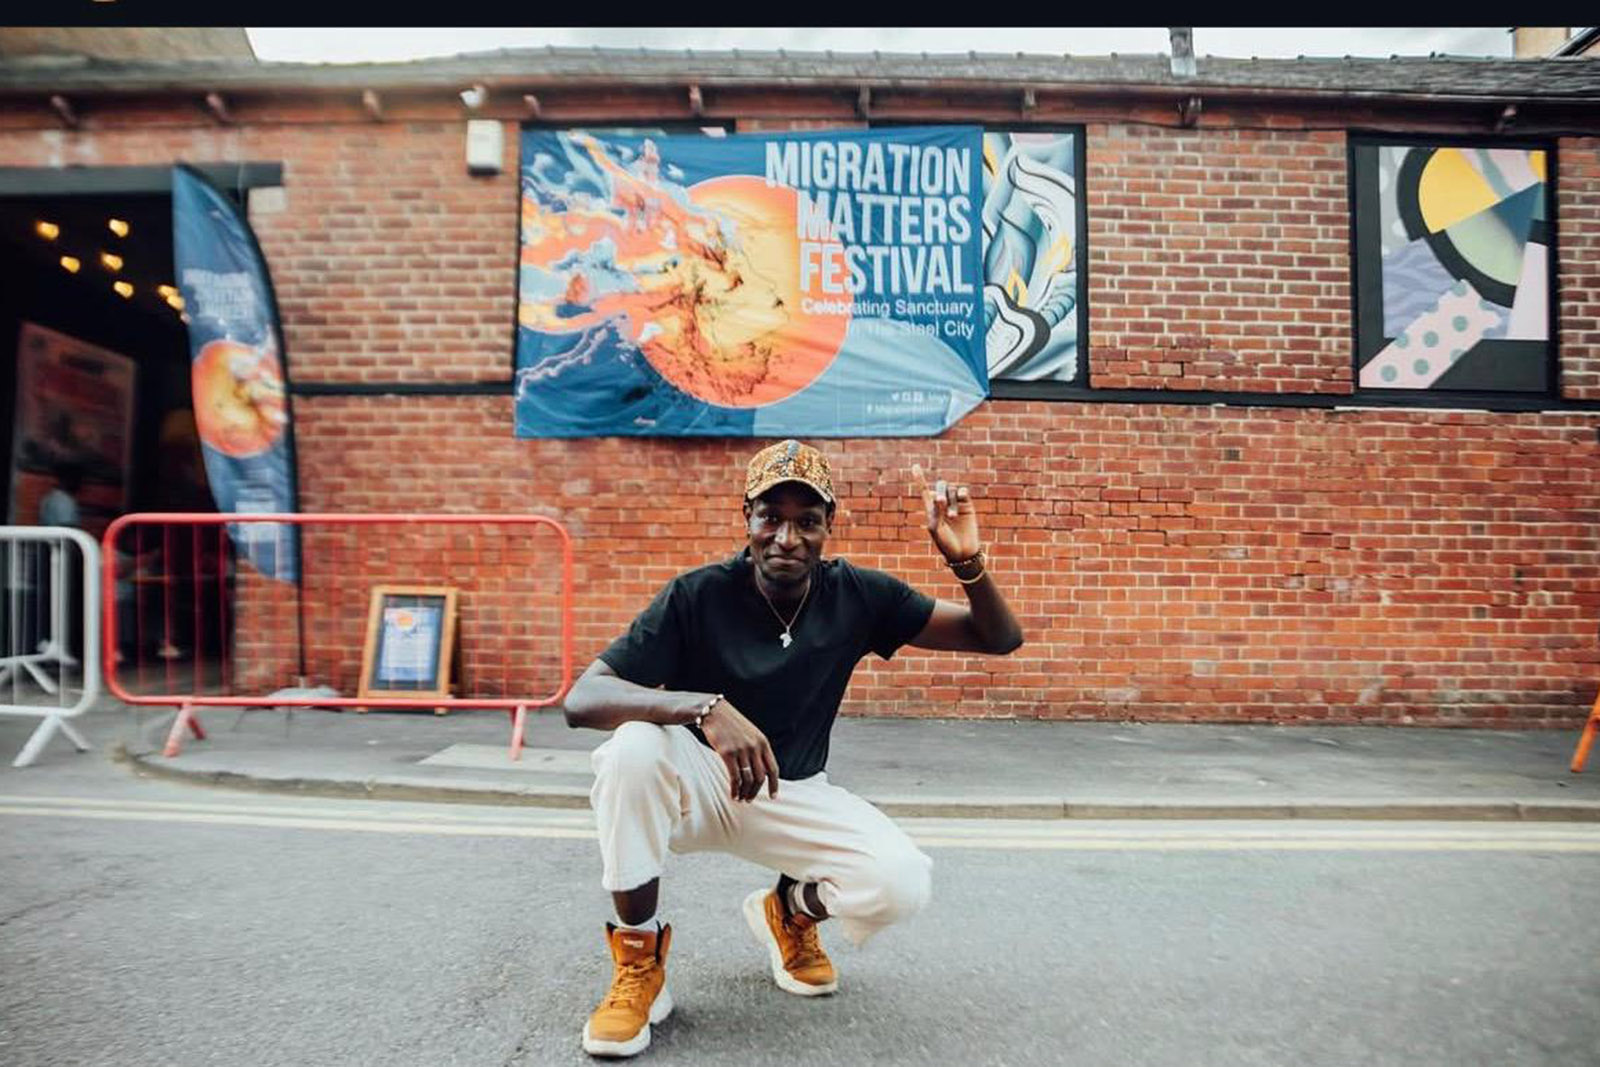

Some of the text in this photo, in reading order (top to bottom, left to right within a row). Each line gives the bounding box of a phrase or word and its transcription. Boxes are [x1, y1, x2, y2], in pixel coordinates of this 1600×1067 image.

[765, 141, 971, 195] MIGRATION
[797, 189, 972, 244] MATTERS
[800, 242, 974, 294] FESTIVAL
[801, 297, 974, 317] Celebrating Sanctuary
[944, 320, 975, 340] City
